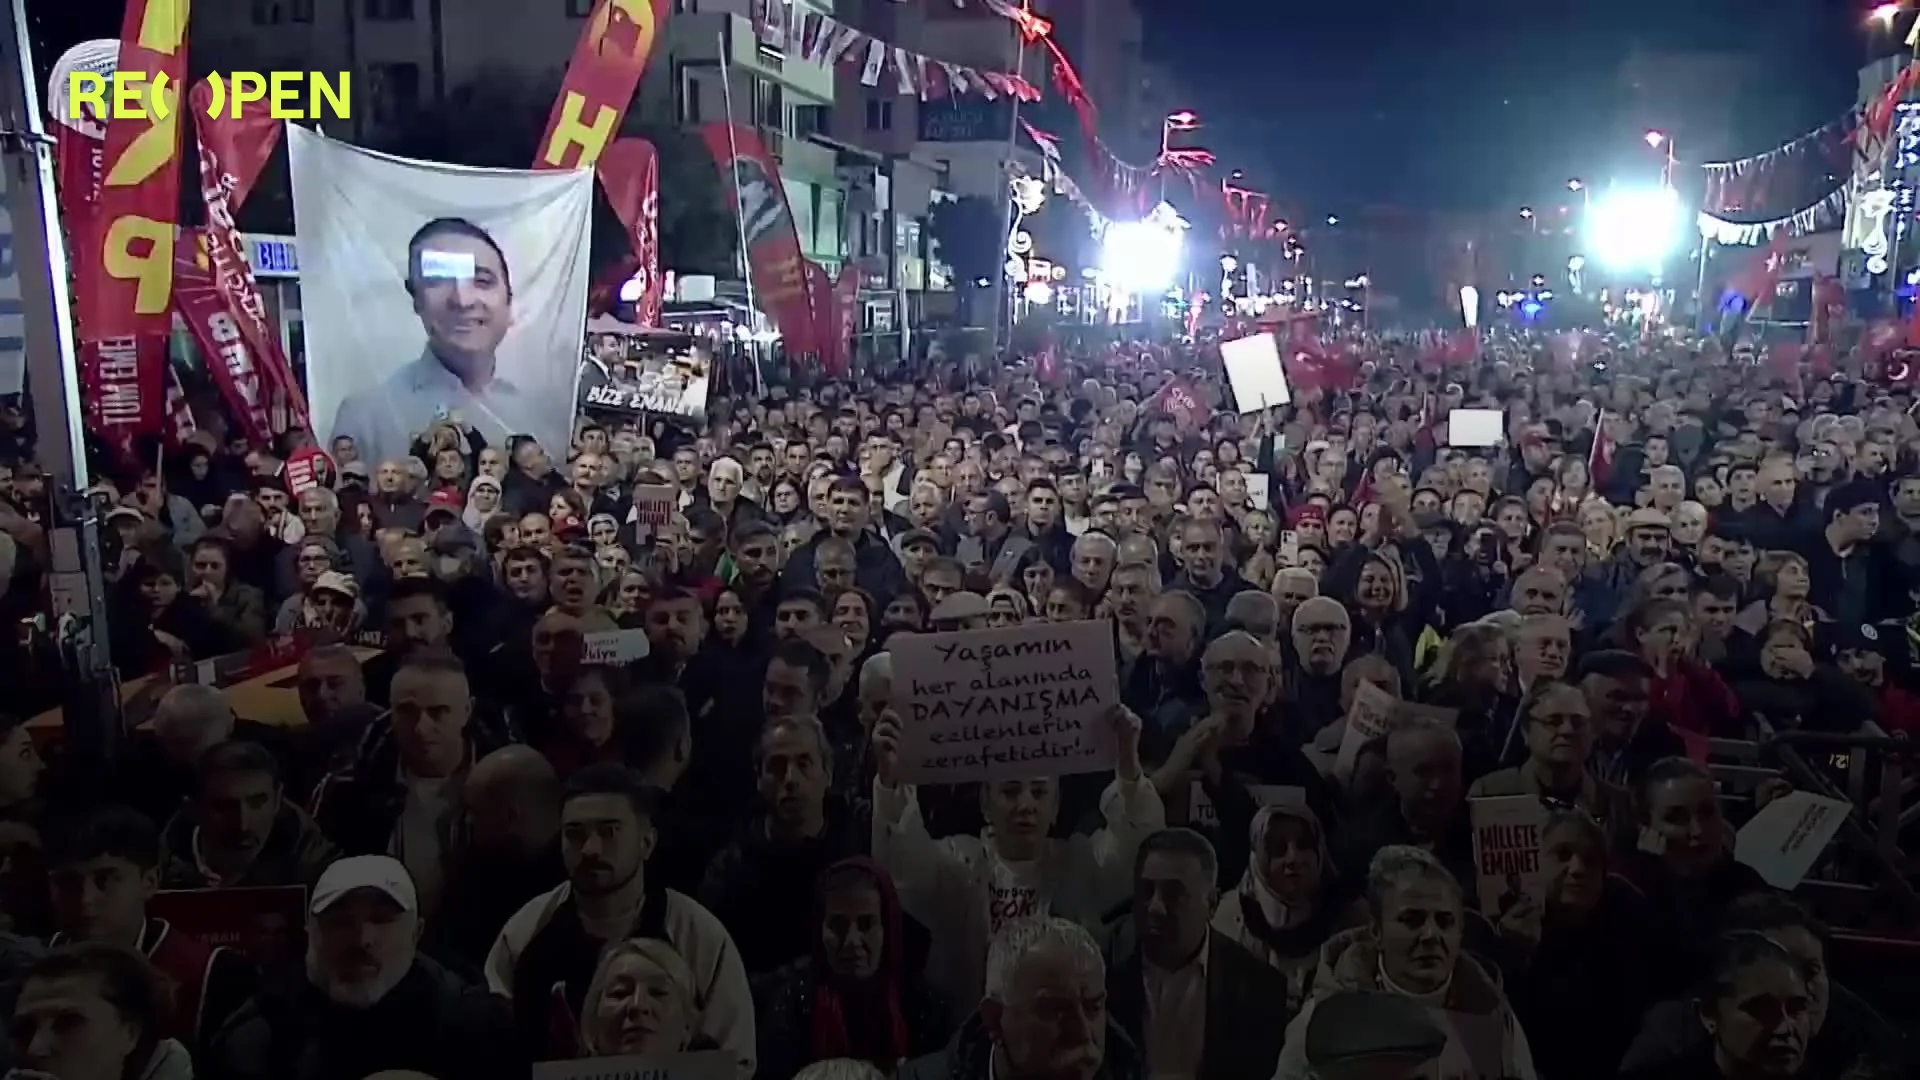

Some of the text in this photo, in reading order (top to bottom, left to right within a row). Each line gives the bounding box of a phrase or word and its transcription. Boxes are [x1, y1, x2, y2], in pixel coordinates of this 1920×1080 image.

[935, 638, 1073, 671] Yaşamın
[912, 664, 1093, 696] her alanında
[910, 686, 1100, 722] DAYANIŞMA
[930, 719, 1082, 744] ezilenlerin
[1480, 823, 1539, 851] MİLLETE
[1481, 849, 1540, 876] EMANET
